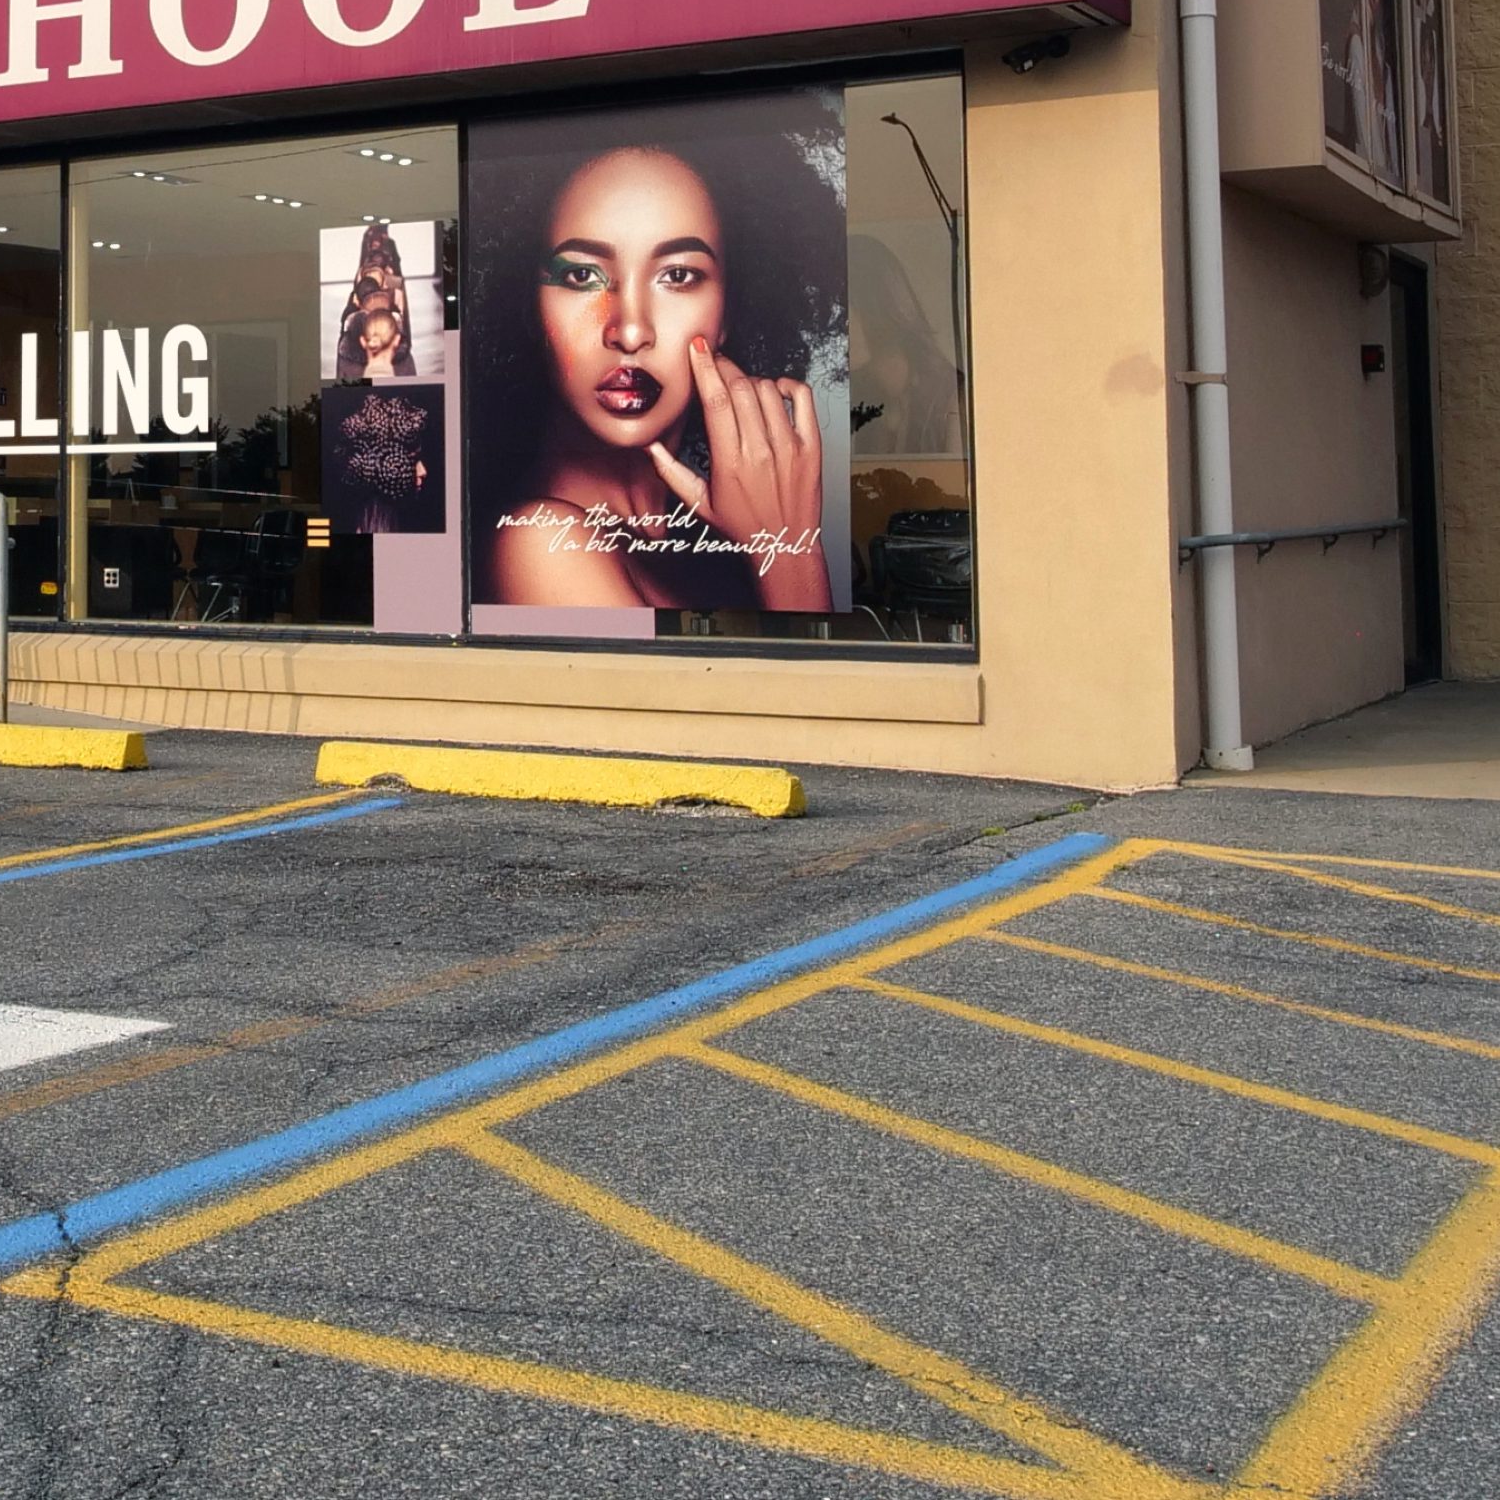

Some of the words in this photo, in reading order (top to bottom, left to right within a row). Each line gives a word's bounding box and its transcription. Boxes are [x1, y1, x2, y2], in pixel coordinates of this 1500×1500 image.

[496, 503, 580, 553] making
[583, 502, 623, 528] the
[627, 501, 700, 528] world
[563, 538, 581, 551] a
[585, 524, 632, 553] bit
[627, 537, 691, 554] more
[693, 520, 822, 577] beautiful!
